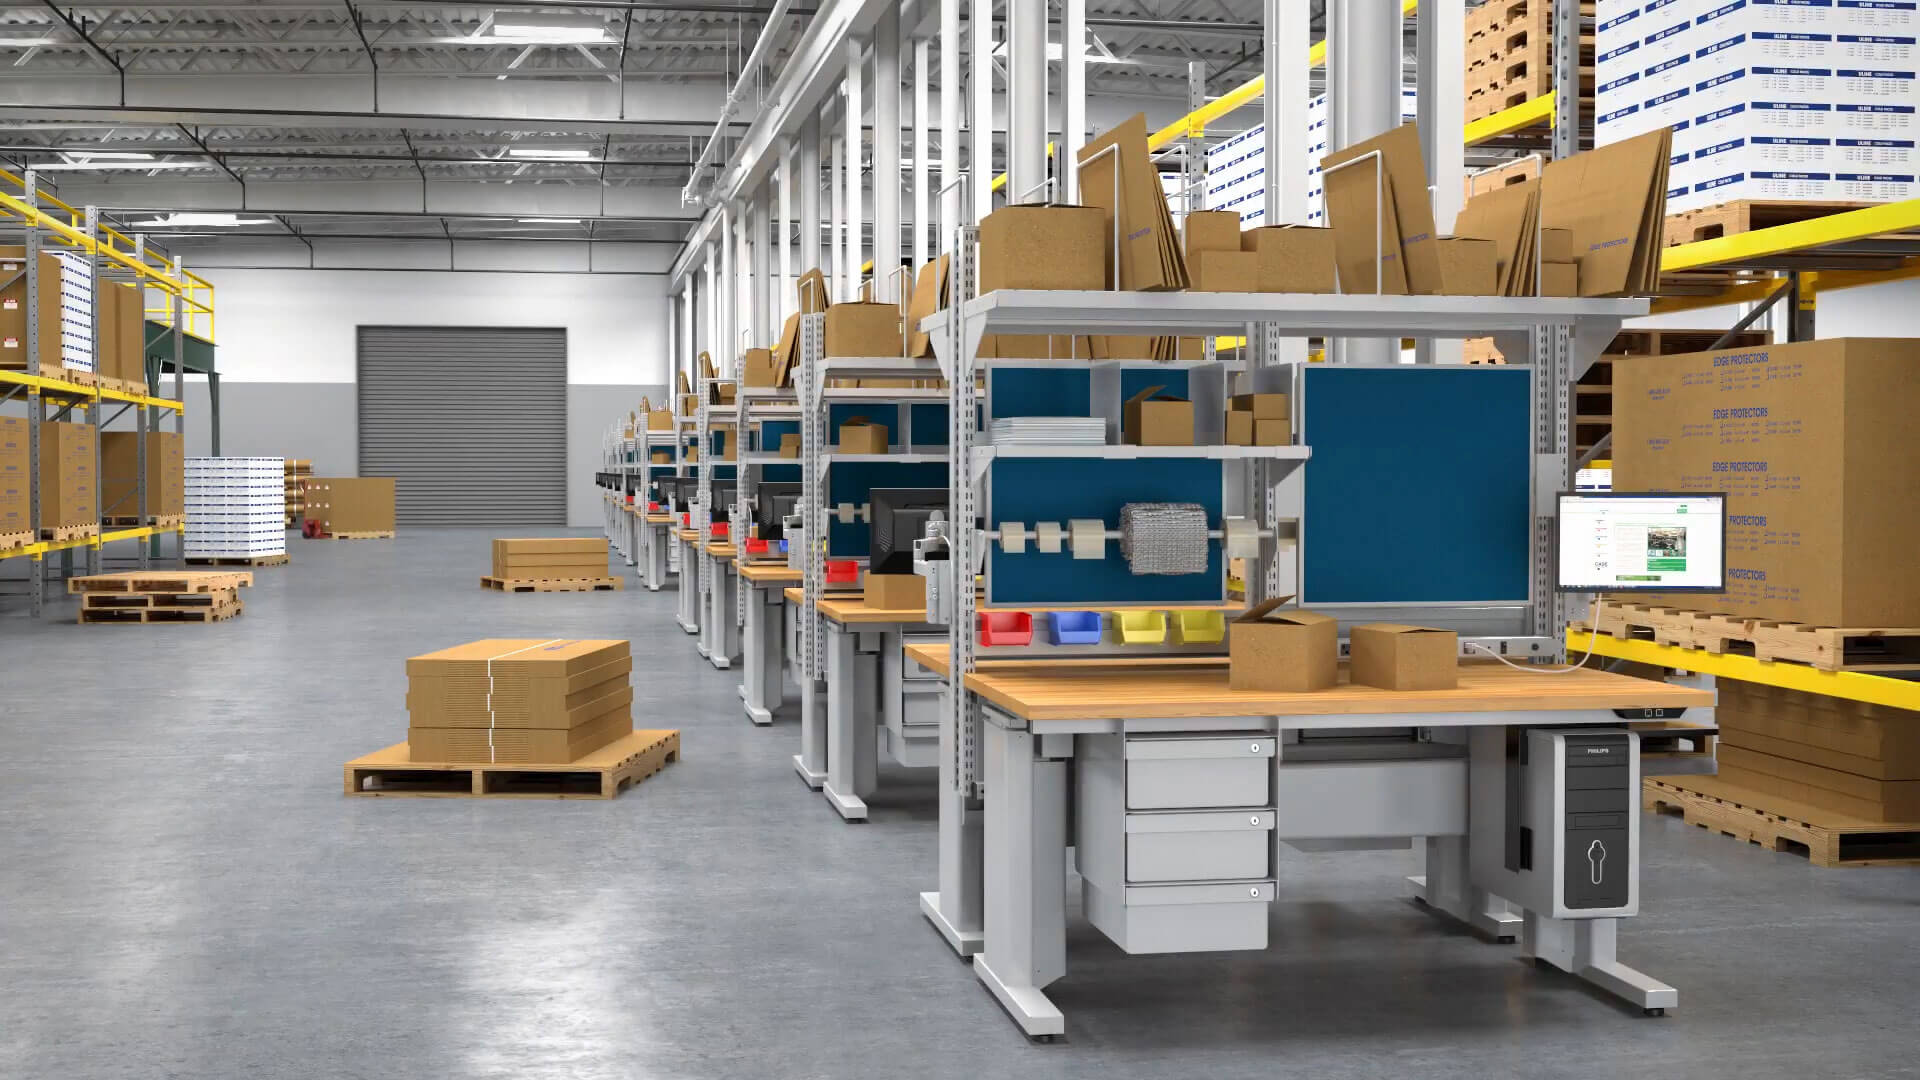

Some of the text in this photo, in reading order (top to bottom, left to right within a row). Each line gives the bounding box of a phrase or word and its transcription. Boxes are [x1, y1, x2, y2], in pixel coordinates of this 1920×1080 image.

[1713, 352, 1768, 367] EDGE PROTECTORS
[1713, 408, 1768, 419] EDGE PROTECTORS
[1712, 462, 1768, 472] EDGE PROTECTORS
[1729, 515, 1767, 526] PROTECTORS
[1728, 568, 1766, 581] PROTECTORS
